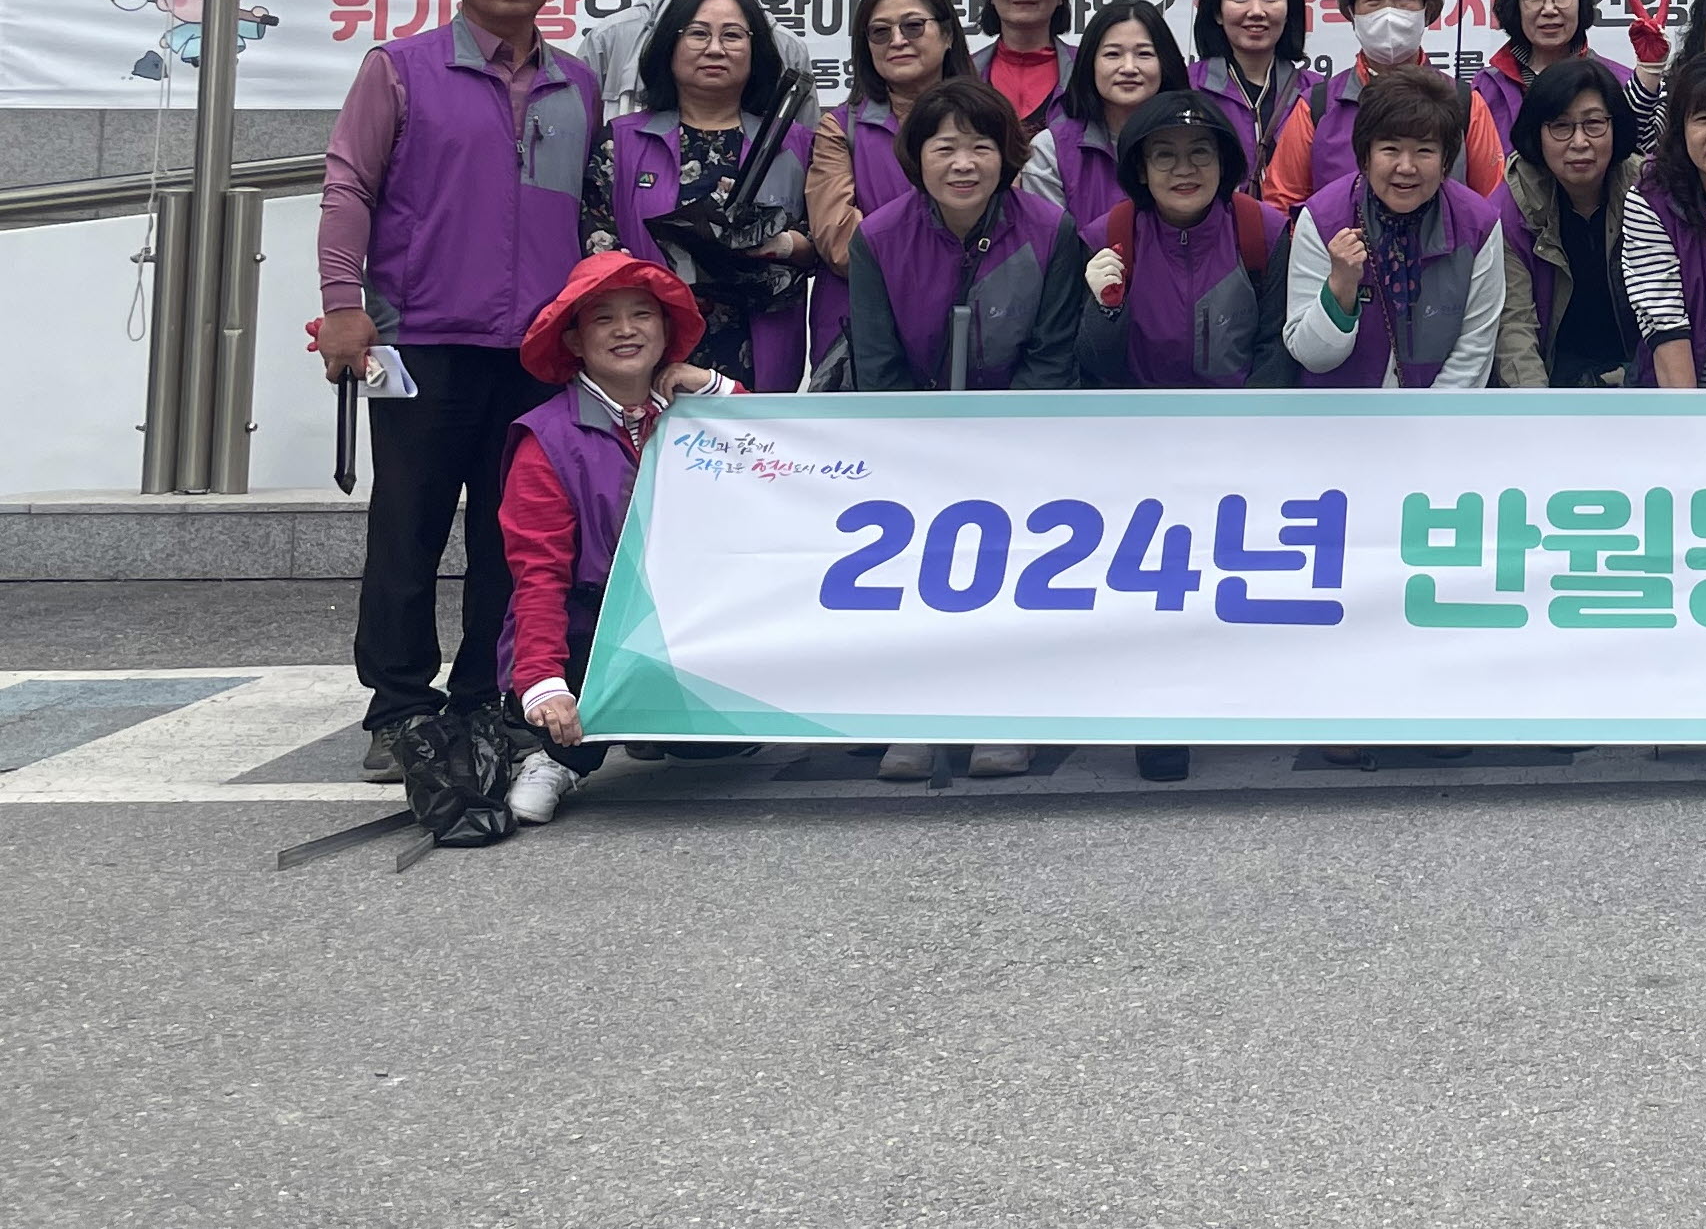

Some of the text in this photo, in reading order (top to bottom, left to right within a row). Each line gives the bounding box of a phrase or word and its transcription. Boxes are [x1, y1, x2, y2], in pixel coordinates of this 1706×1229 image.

[674, 429, 731, 458] 시민과
[685, 457, 873, 484] 자유로운 혁신도시 안산
[818, 487, 1347, 627] 2024년
